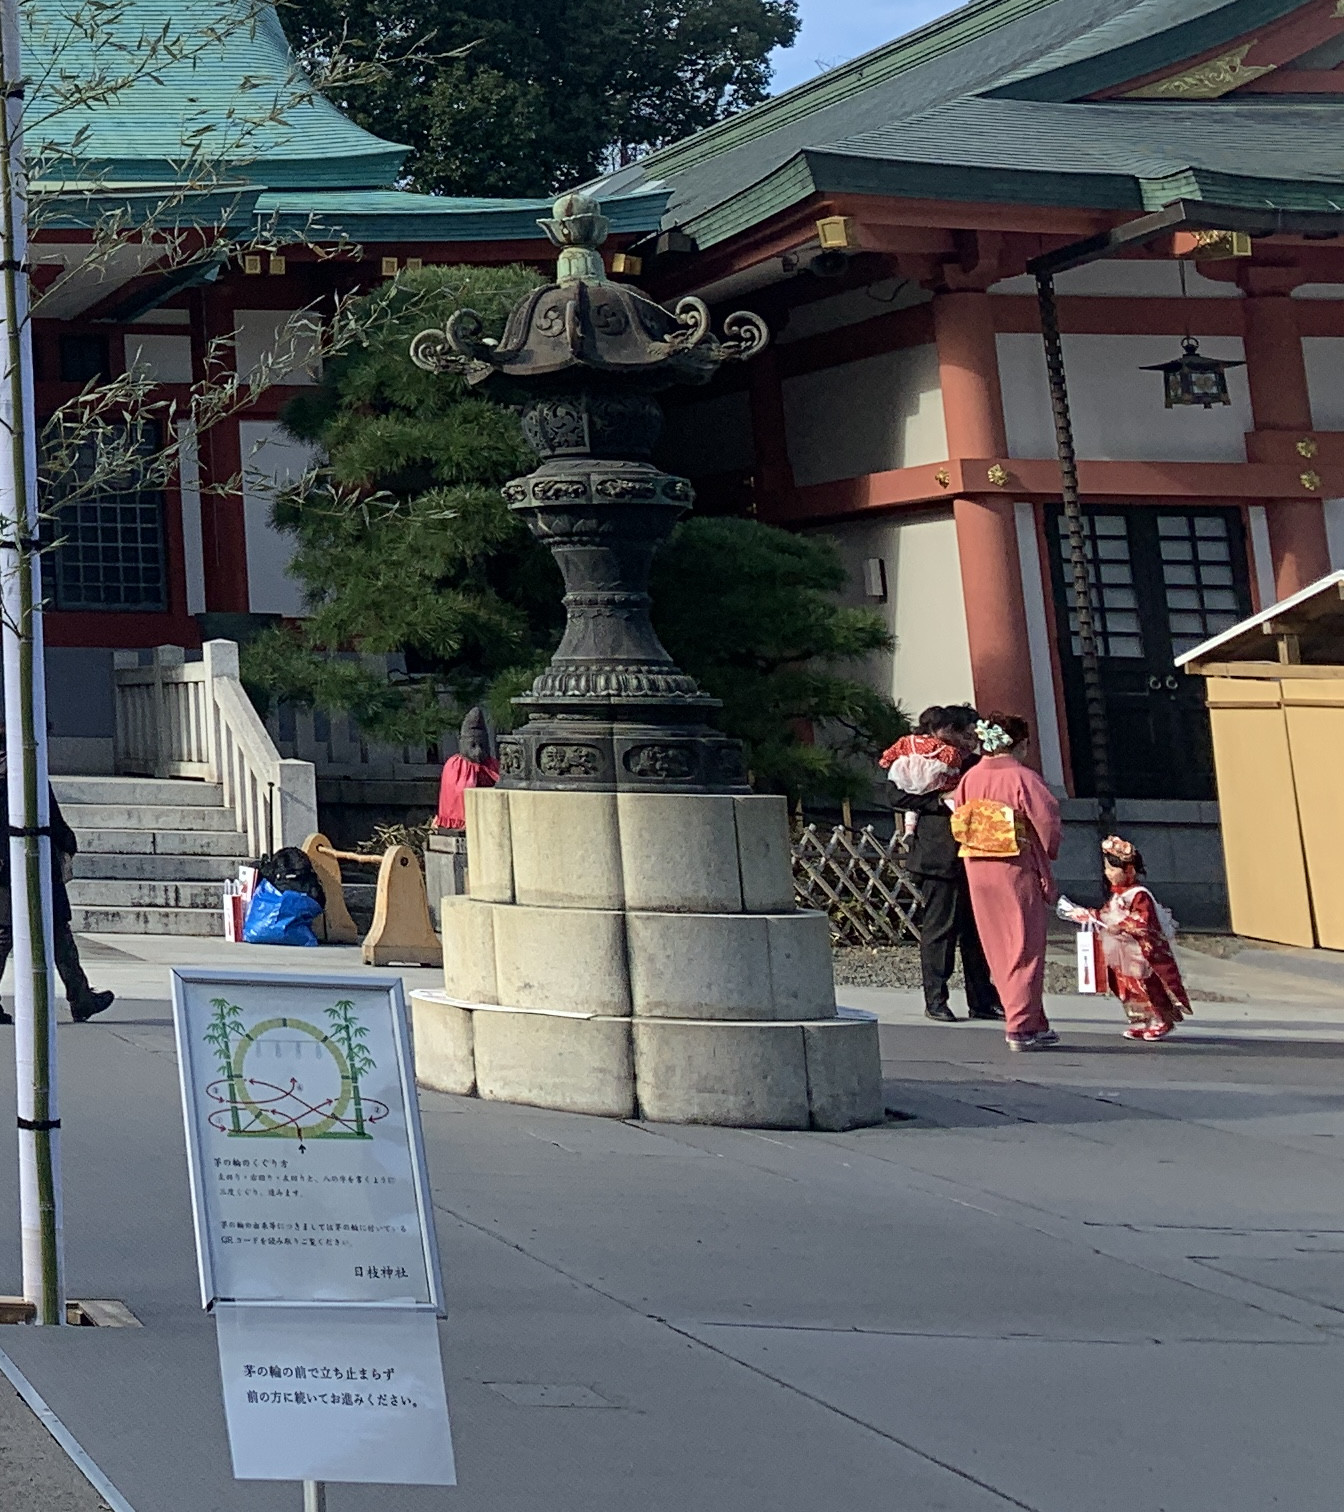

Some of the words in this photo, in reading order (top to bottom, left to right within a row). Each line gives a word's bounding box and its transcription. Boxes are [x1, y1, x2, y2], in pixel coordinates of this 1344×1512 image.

[213, 1157, 289, 1168] 茅の輪のくぐり方
[354, 1265, 409, 1279] 日枝神社
[243, 1364, 395, 1381] 茅の輪の前で立ち止まらず
[247, 1390, 418, 1408] 前の方に続いてお進みください。
